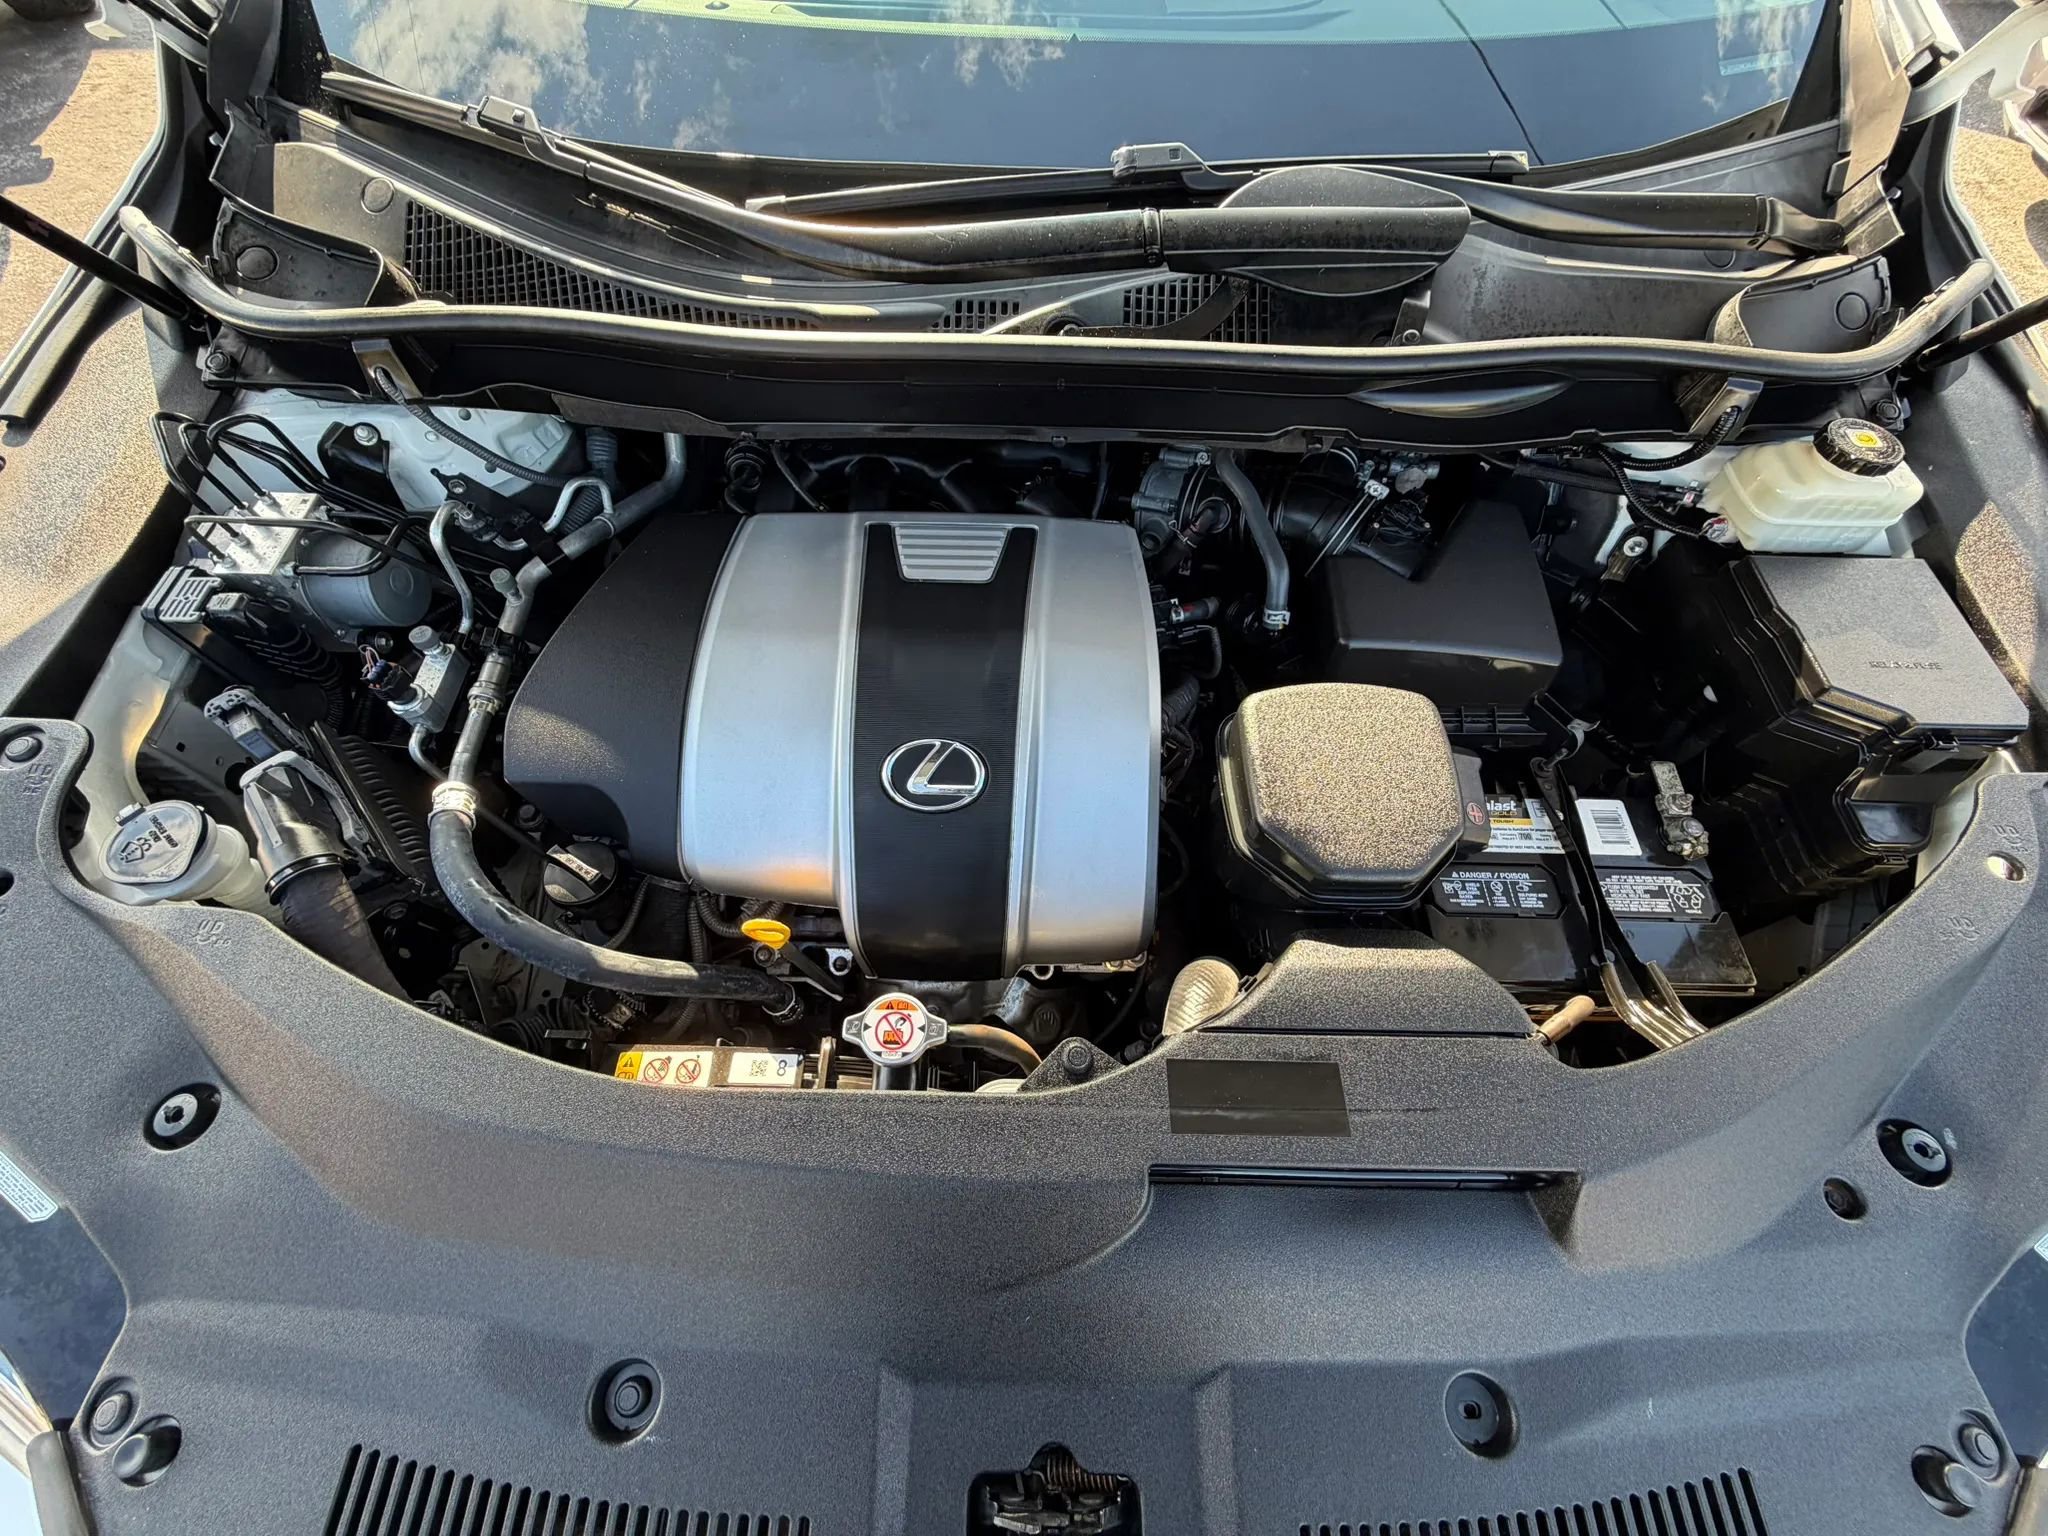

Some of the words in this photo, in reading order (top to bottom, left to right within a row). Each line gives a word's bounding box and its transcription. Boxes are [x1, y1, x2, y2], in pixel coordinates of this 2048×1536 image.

[1460, 871, 1492, 879] DANGER
[1500, 872, 1530, 880] POISON
[777, 1059, 788, 1077] 8
